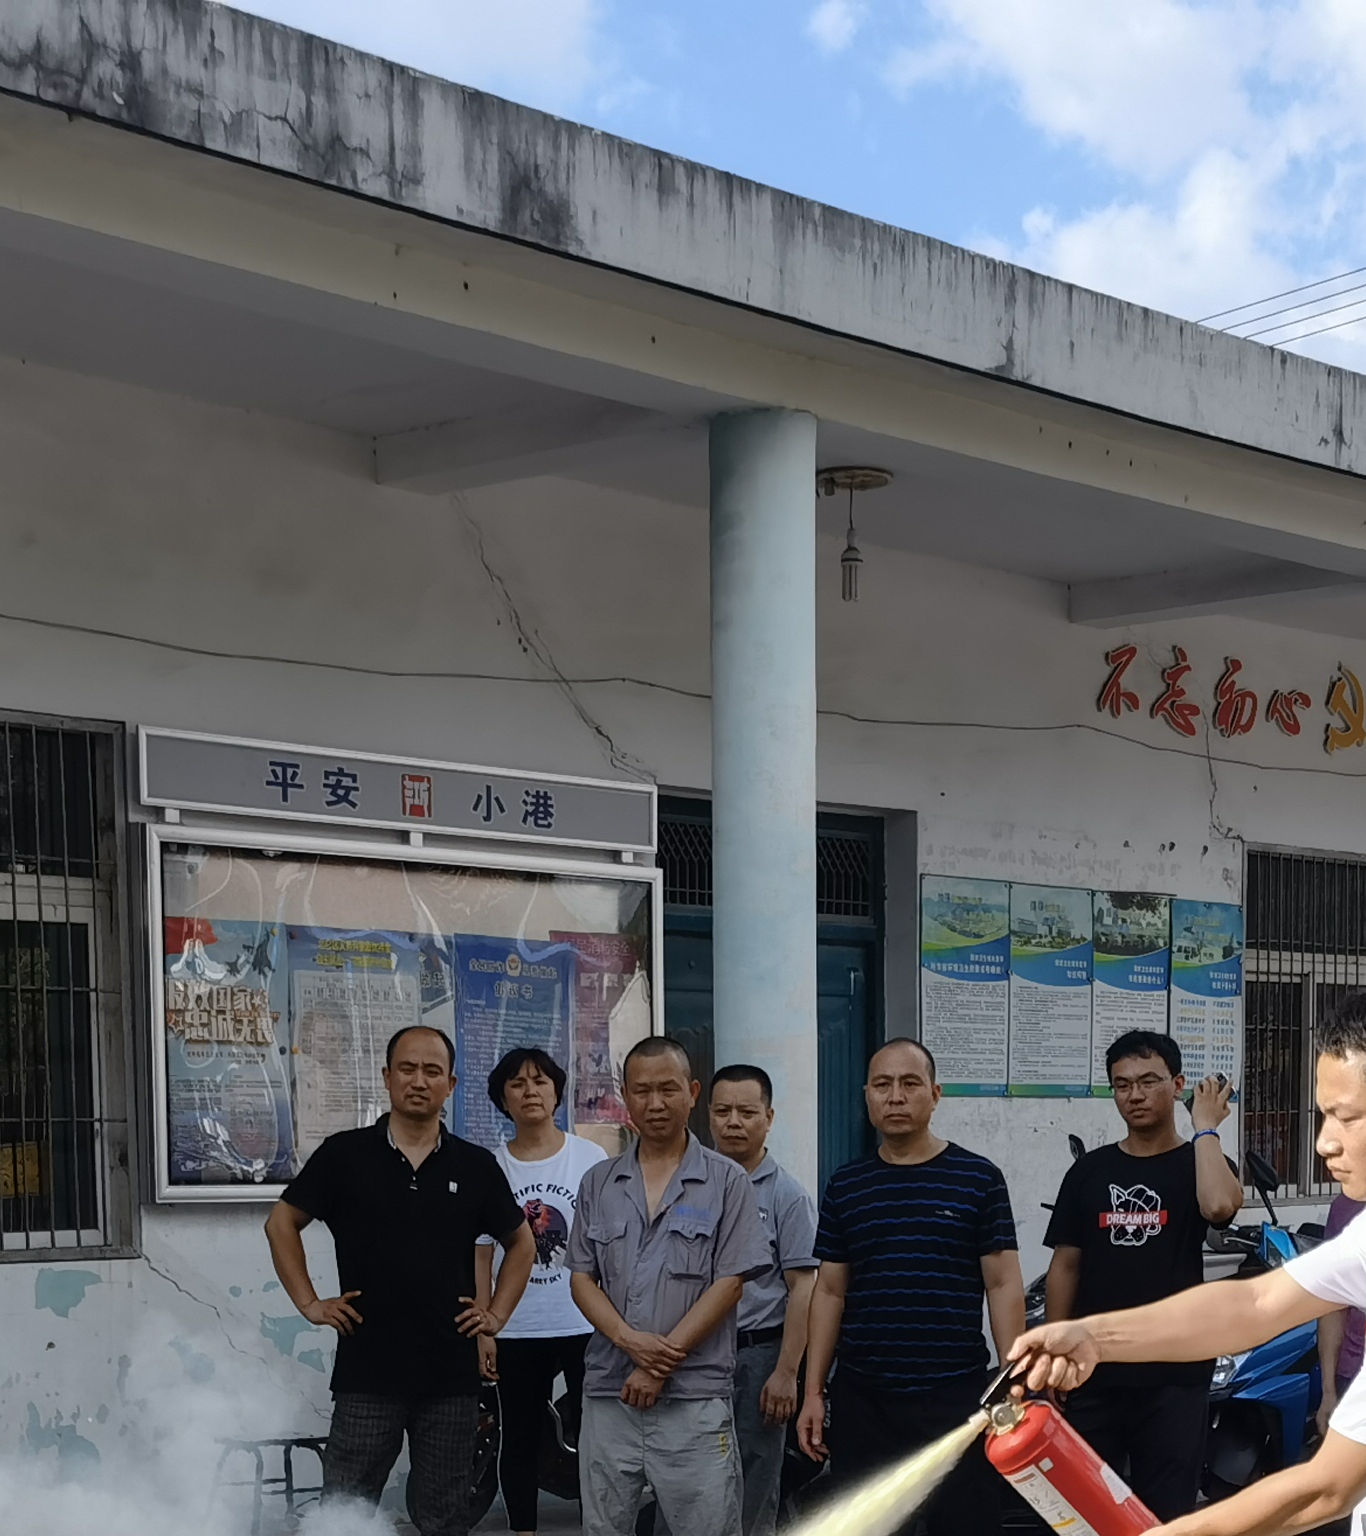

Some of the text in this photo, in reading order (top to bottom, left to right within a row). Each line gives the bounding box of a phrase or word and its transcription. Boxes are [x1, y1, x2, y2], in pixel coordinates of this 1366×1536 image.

[1097, 645, 1311, 738] 不忘初心
[265, 760, 556, 830] 平安 小港
[514, 1183, 577, 1210] TIFIC FICTIO
[1106, 1212, 1160, 1225] DREAM BIG
